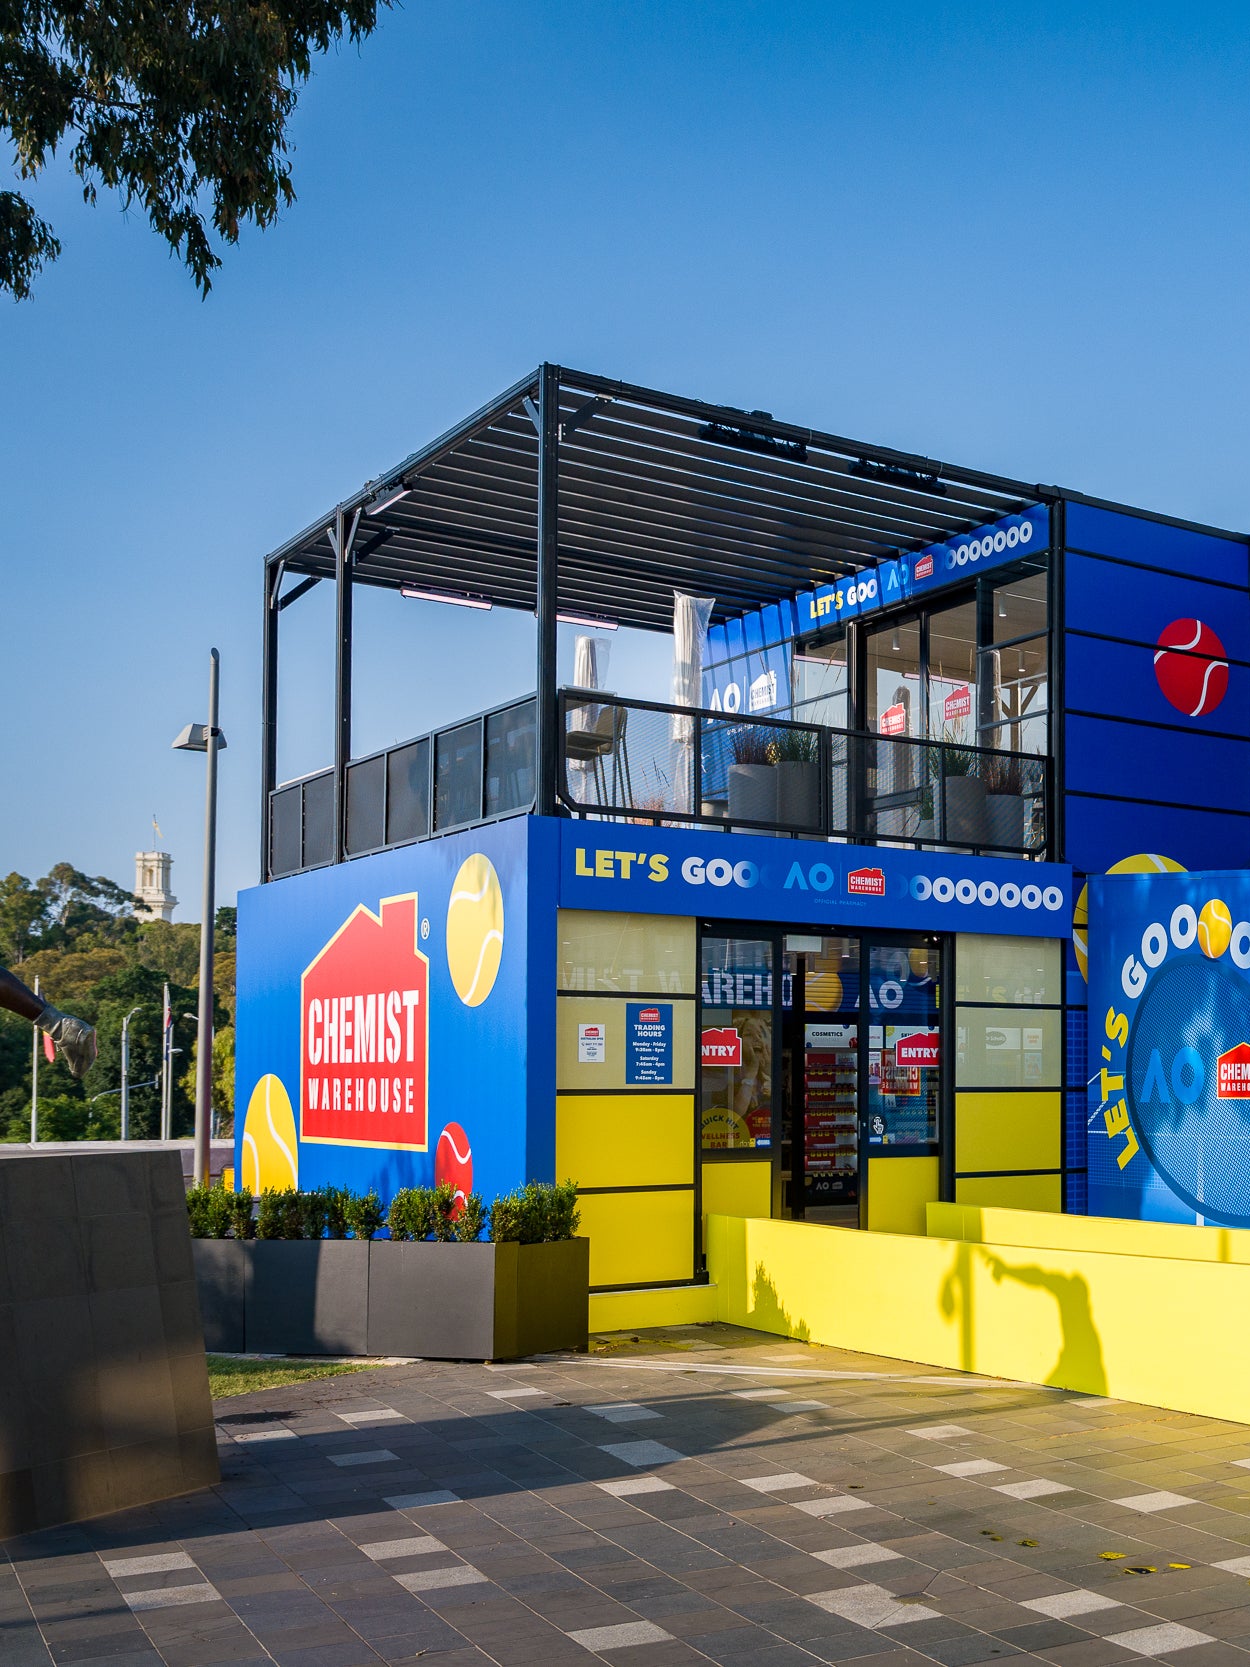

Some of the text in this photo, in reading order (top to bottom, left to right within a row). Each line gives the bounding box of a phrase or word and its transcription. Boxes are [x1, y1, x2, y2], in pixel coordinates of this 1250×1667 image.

[810, 590, 844, 619] LET'S
[575, 847, 669, 882] LET'S
[783, 861, 835, 892] AO
[850, 875, 883, 887] CHEMIST
[850, 884, 882, 892] WAREHOUSE
[308, 989, 419, 1066] CHEMIST
[702, 1045, 737, 1057] NTRY
[901, 1047, 939, 1058] ENTRY
[1100, 1006, 1140, 1171] LET'S
[1140, 1046, 1205, 1105] AO
[308, 1077, 415, 1114] WAREHOUSE
[726, 1117, 739, 1130] HIT
